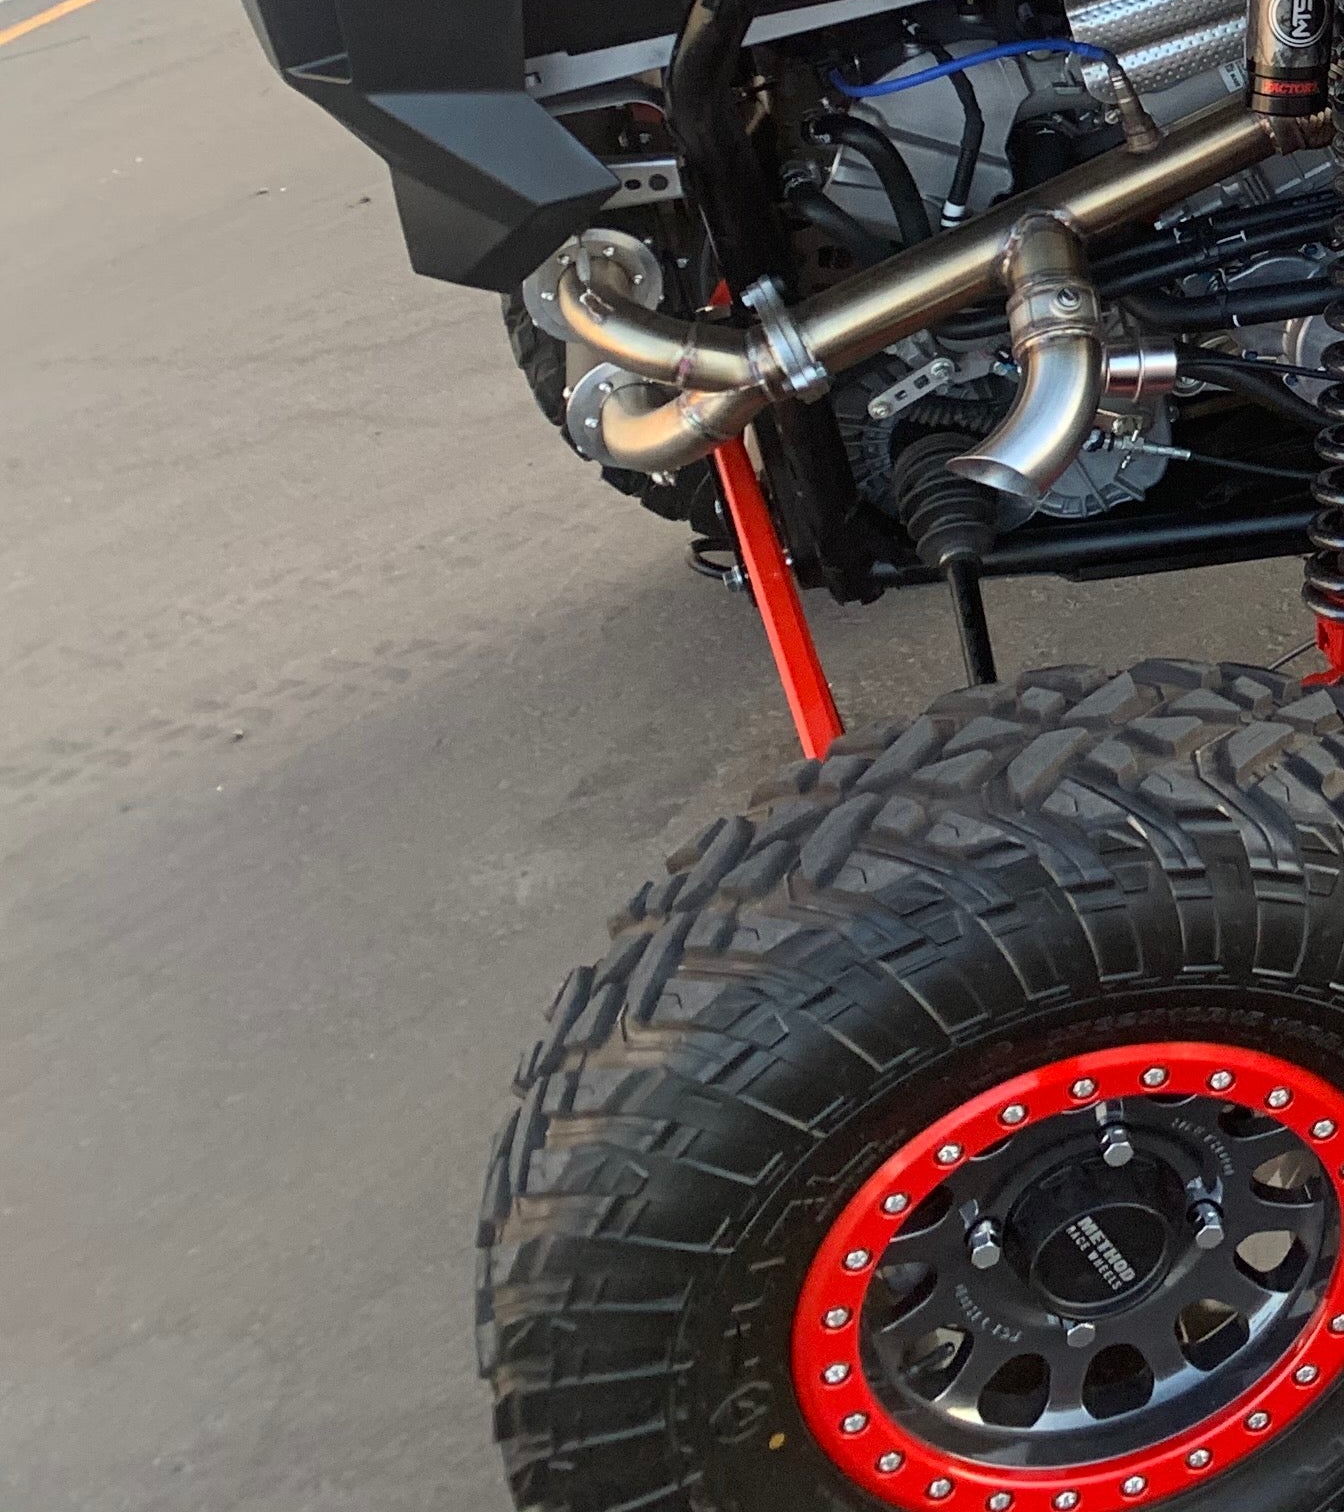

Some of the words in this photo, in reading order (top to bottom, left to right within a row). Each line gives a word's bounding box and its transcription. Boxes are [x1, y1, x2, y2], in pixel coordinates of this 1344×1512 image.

[1066, 1225, 1090, 1252] RACE
[1088, 1250, 1122, 1290] WHEELS
[1077, 1216, 1135, 1282] METHOD
